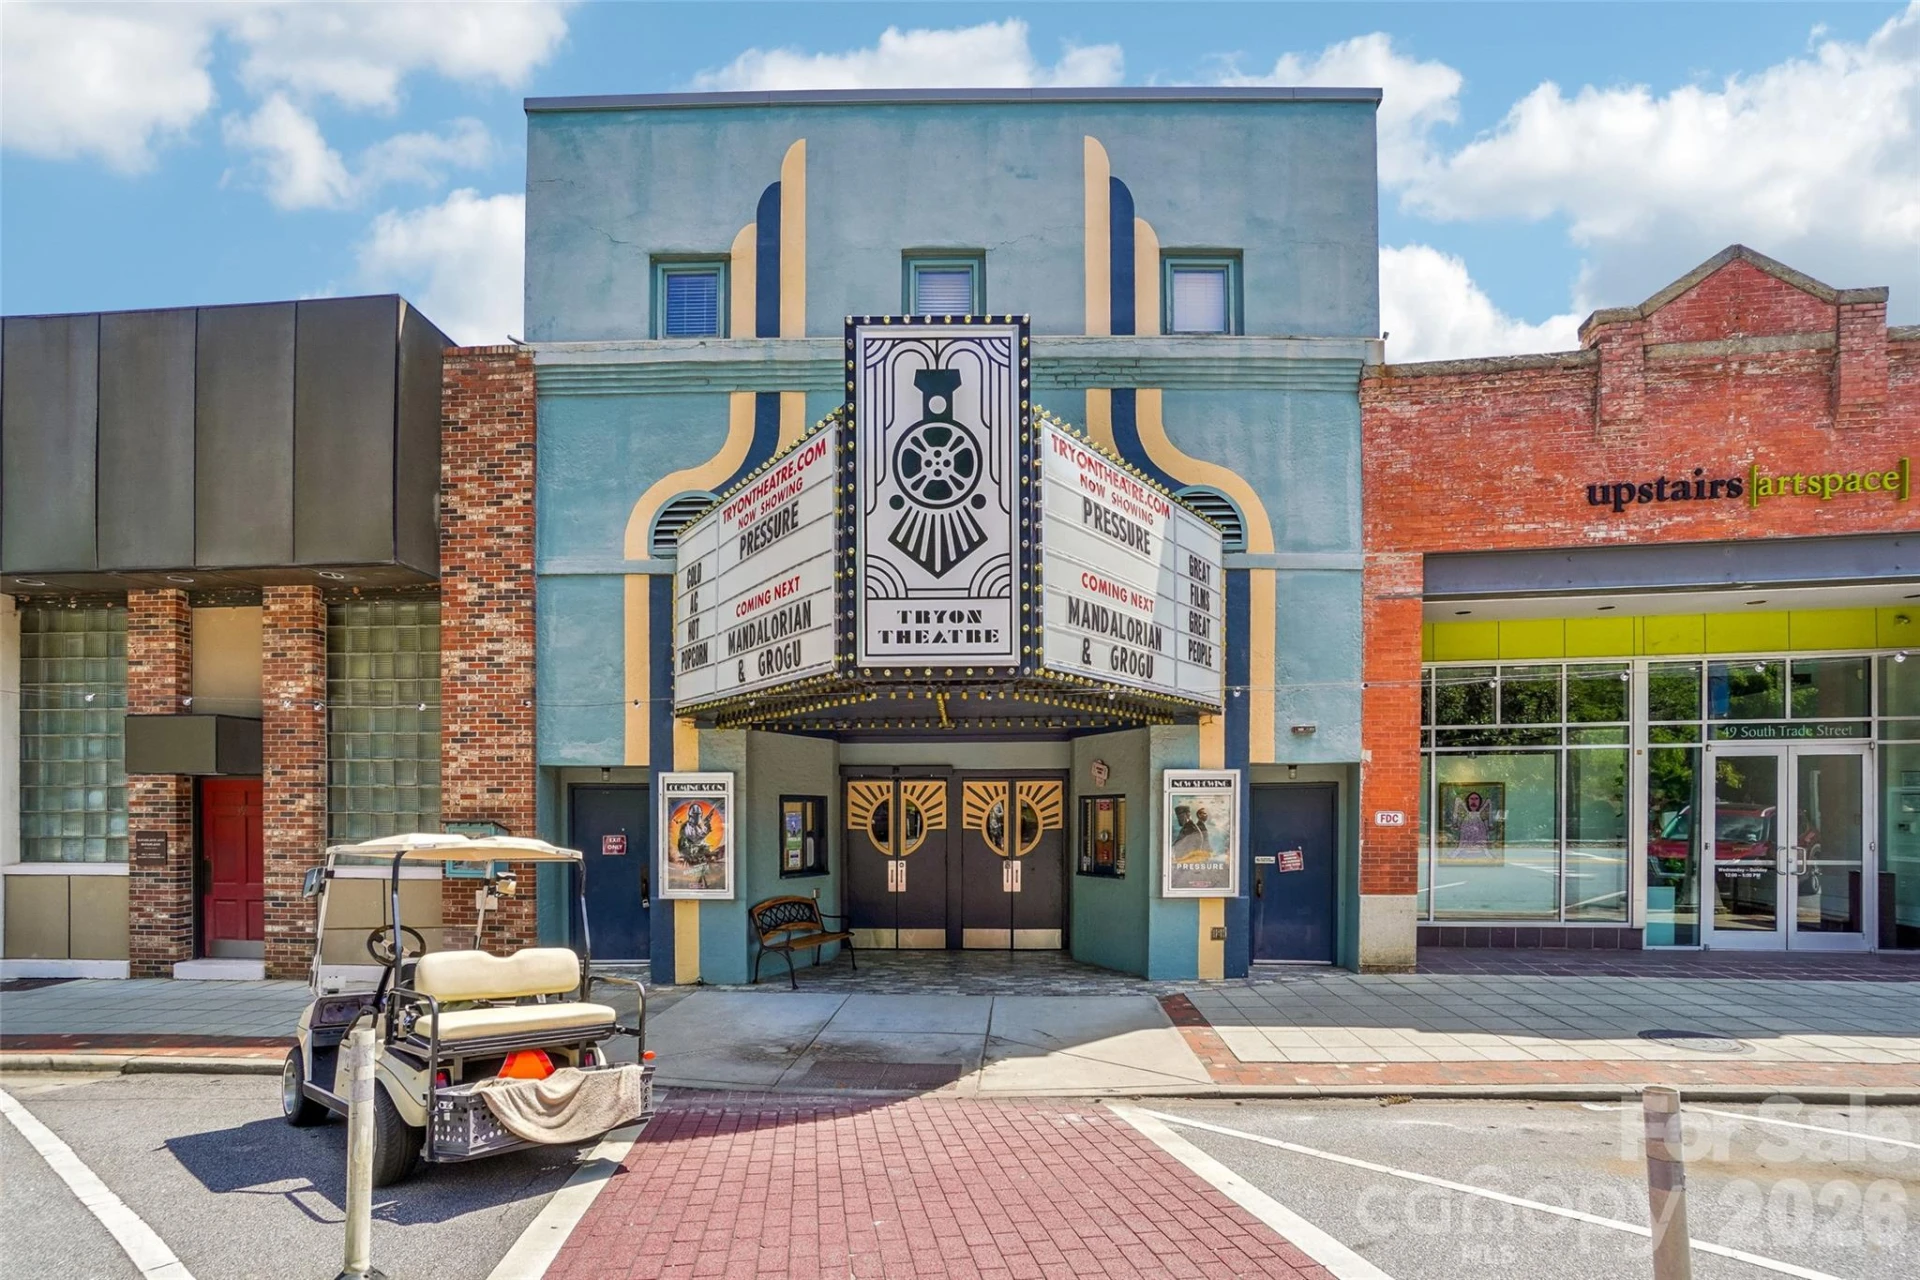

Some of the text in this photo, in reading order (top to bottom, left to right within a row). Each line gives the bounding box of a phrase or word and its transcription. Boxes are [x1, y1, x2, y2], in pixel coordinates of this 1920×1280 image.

[722, 438, 827, 524] TRYONTHEATRE.COM
[1051, 434, 1170, 520] TRYONTHEATRE.COM
[1587, 467, 1744, 513] upstairs
[738, 477, 803, 530] NOW SHOWING
[1080, 473, 1154, 526] NOW SHOWING
[739, 501, 800, 560] PRESSURE
[1083, 496, 1151, 554] PRESSURE
[687, 562, 702, 590] COLD
[1188, 555, 1210, 586] GREAT
[735, 576, 801, 618] COMING NEXT
[1081, 572, 1154, 613] COMING NEXT
[1190, 583, 1210, 611] FILMS
[687, 617, 700, 643] HOT
[728, 600, 812, 656] MANDALORIAN
[878, 629, 999, 644] THEATRE
[897, 610, 982, 624] TRYON
[1068, 596, 1162, 651] MANDALORIAN
[1188, 611, 1210, 640] GREAT
[681, 641, 708, 672] POPCORN
[737, 639, 801, 683] & GROGU
[1082, 638, 1154, 679] & GROGU
[1188, 639, 1212, 667] PEOPLE
[1723, 724, 1853, 738] 49 South Trade Street
[1380, 814, 1399, 823] FDC
